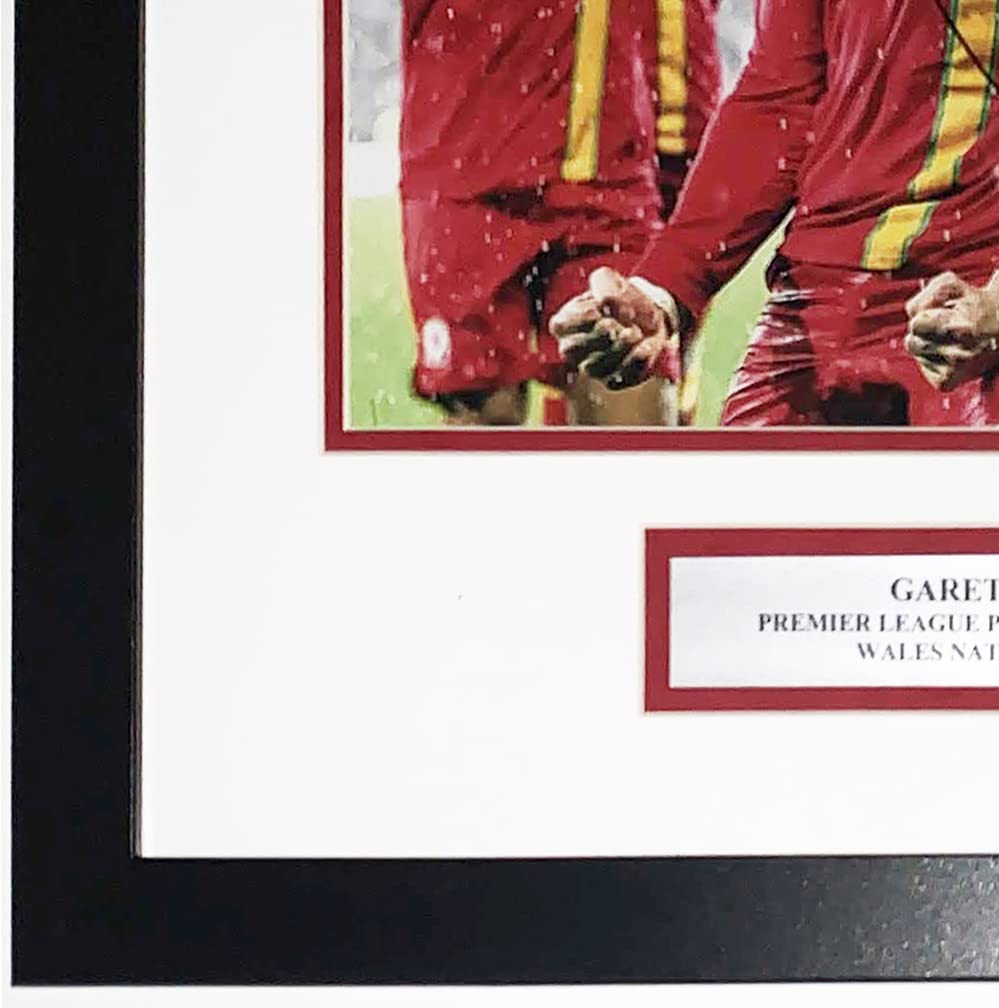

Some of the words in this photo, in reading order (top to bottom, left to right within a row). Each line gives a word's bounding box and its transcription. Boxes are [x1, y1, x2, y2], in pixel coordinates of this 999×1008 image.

[758, 613, 871, 632] PREMIER
[879, 613, 980, 632] LEAGUE
[857, 643, 942, 661] WALES
